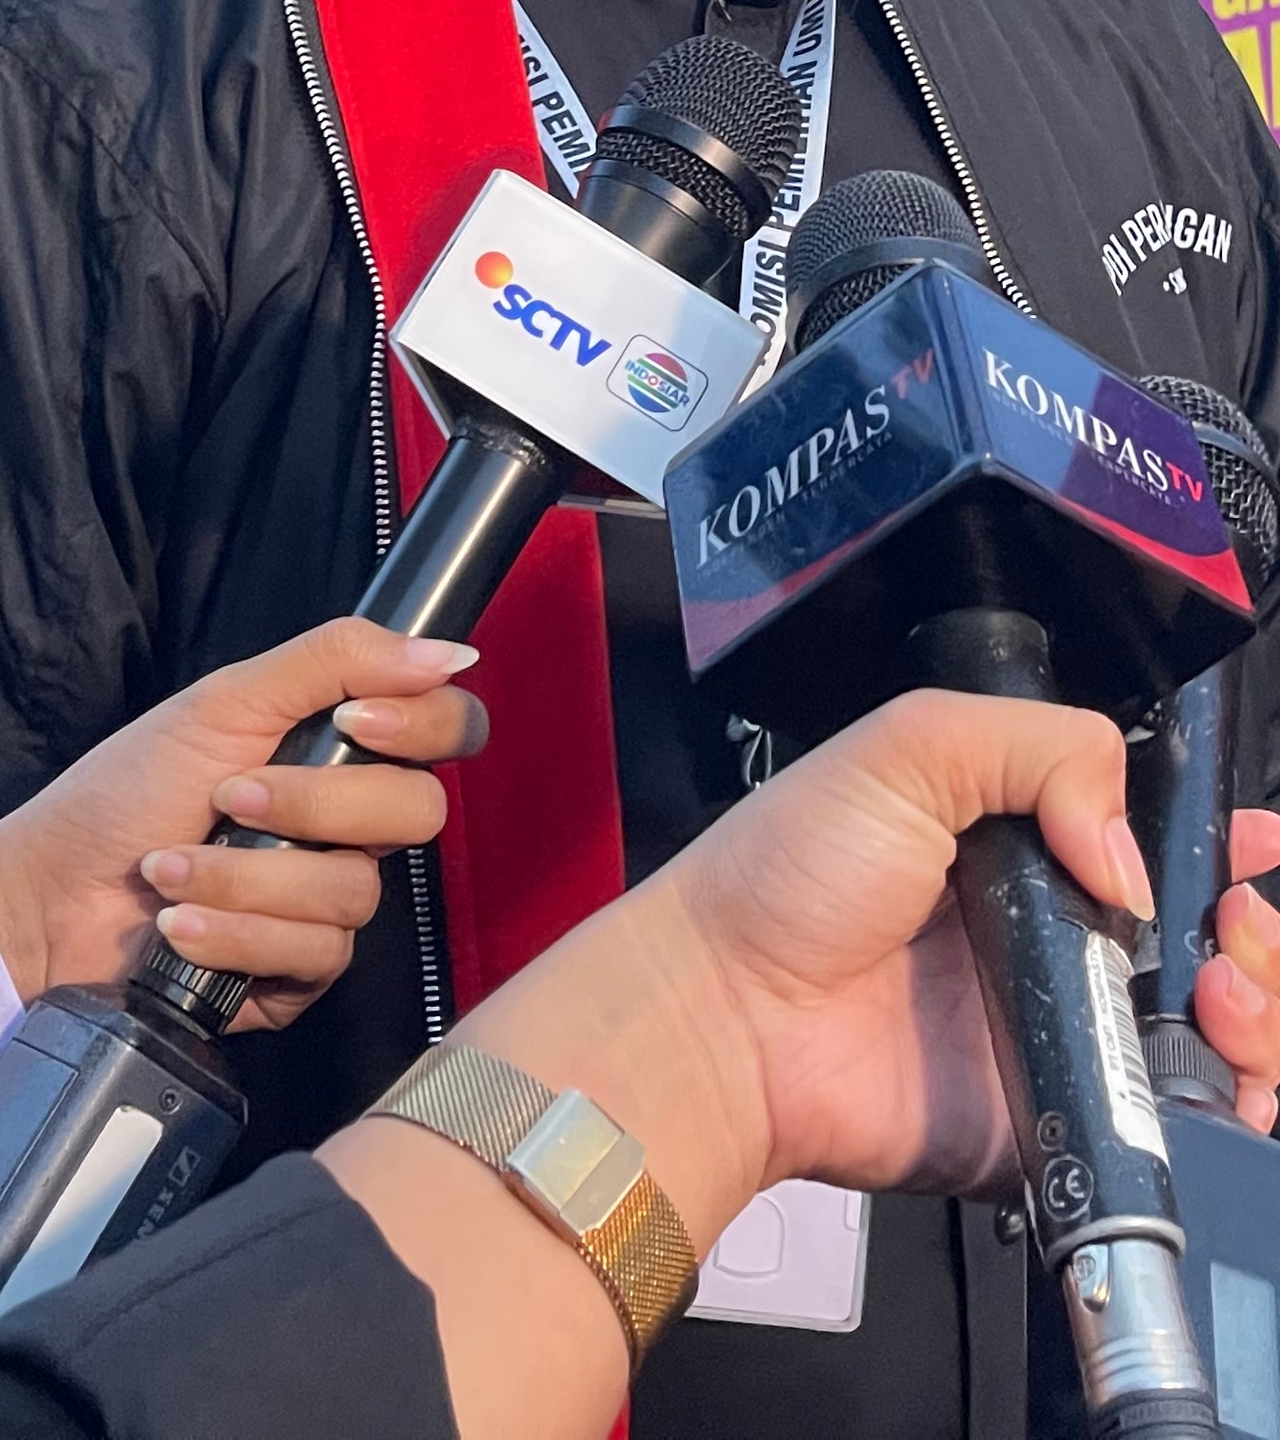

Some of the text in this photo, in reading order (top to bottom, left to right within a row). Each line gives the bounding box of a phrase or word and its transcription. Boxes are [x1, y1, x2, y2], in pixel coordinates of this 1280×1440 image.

[492, 284, 613, 367] SCTV
[749, 239, 787, 366] OMISI
[624, 359, 691, 409] INDOSIAR
